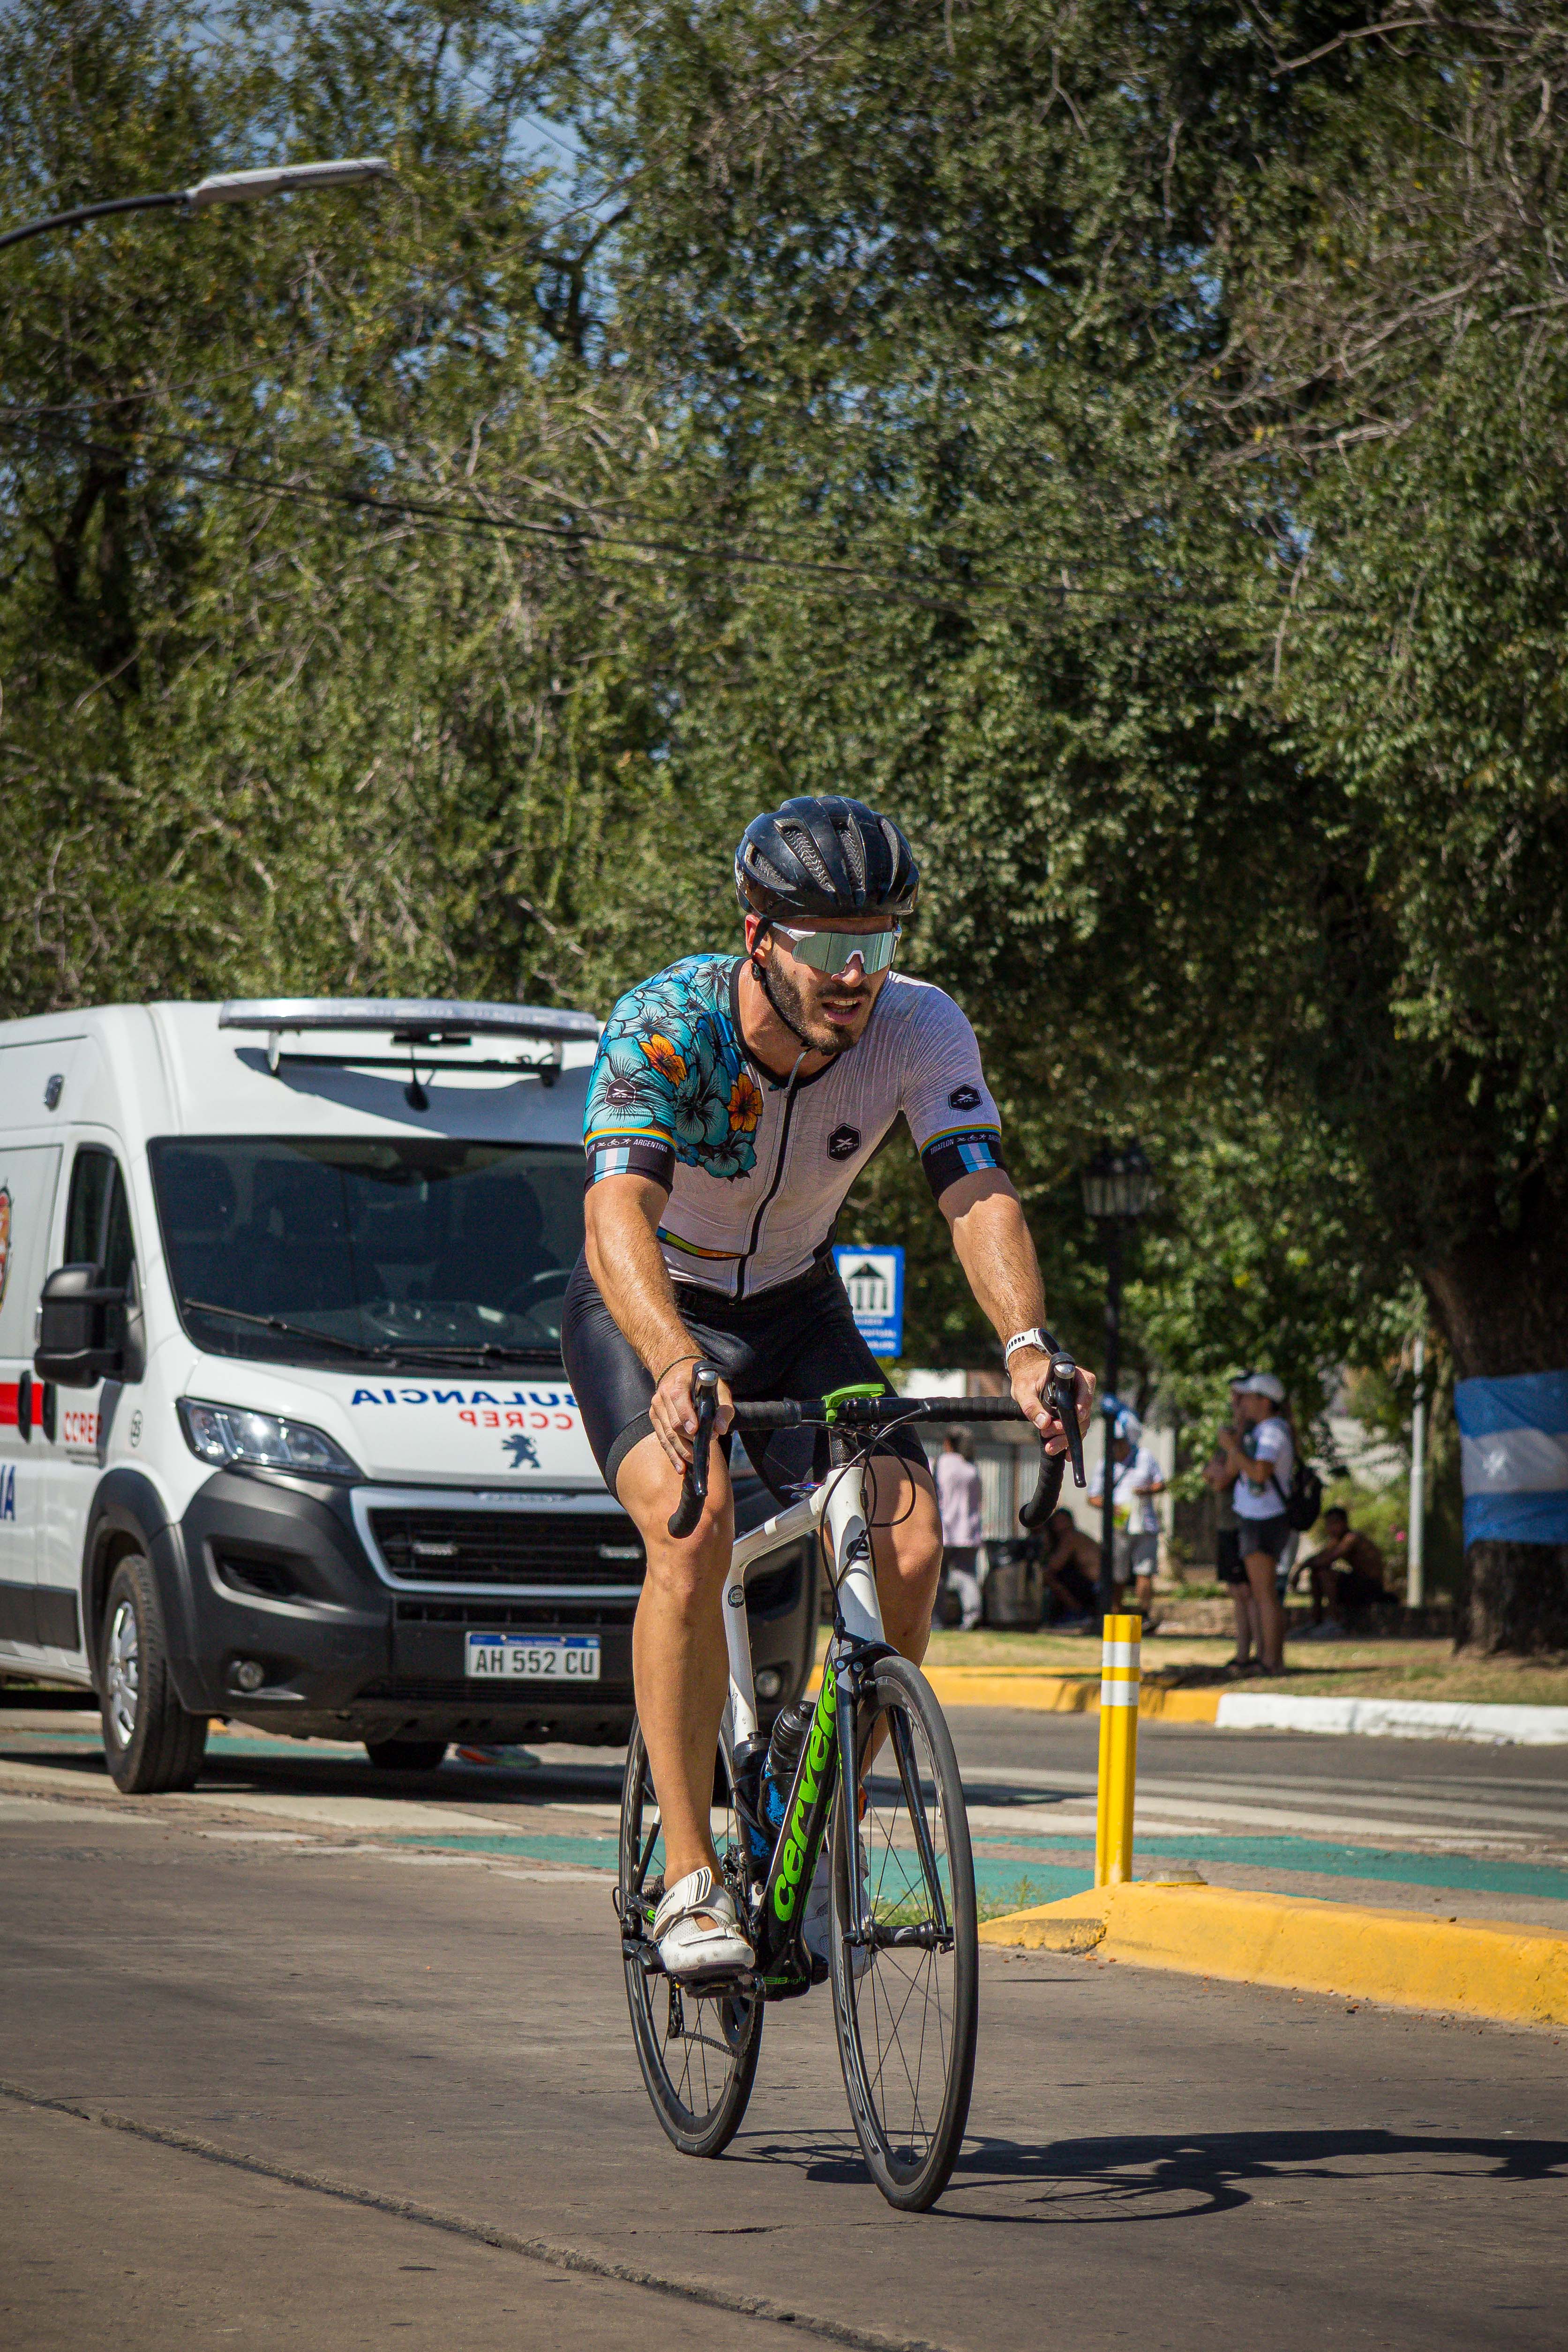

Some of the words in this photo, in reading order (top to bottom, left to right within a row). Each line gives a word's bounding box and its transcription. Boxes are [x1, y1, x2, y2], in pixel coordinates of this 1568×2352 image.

[633, 1139, 668, 1153] ARGENTINA
[930, 1138, 954, 1154] TRIATLON
[64, 1411, 103, 1444] CCREP
[475, 1649, 503, 1672] AH
[513, 1649, 556, 1673] 552
[565, 1651, 594, 1674] CU
